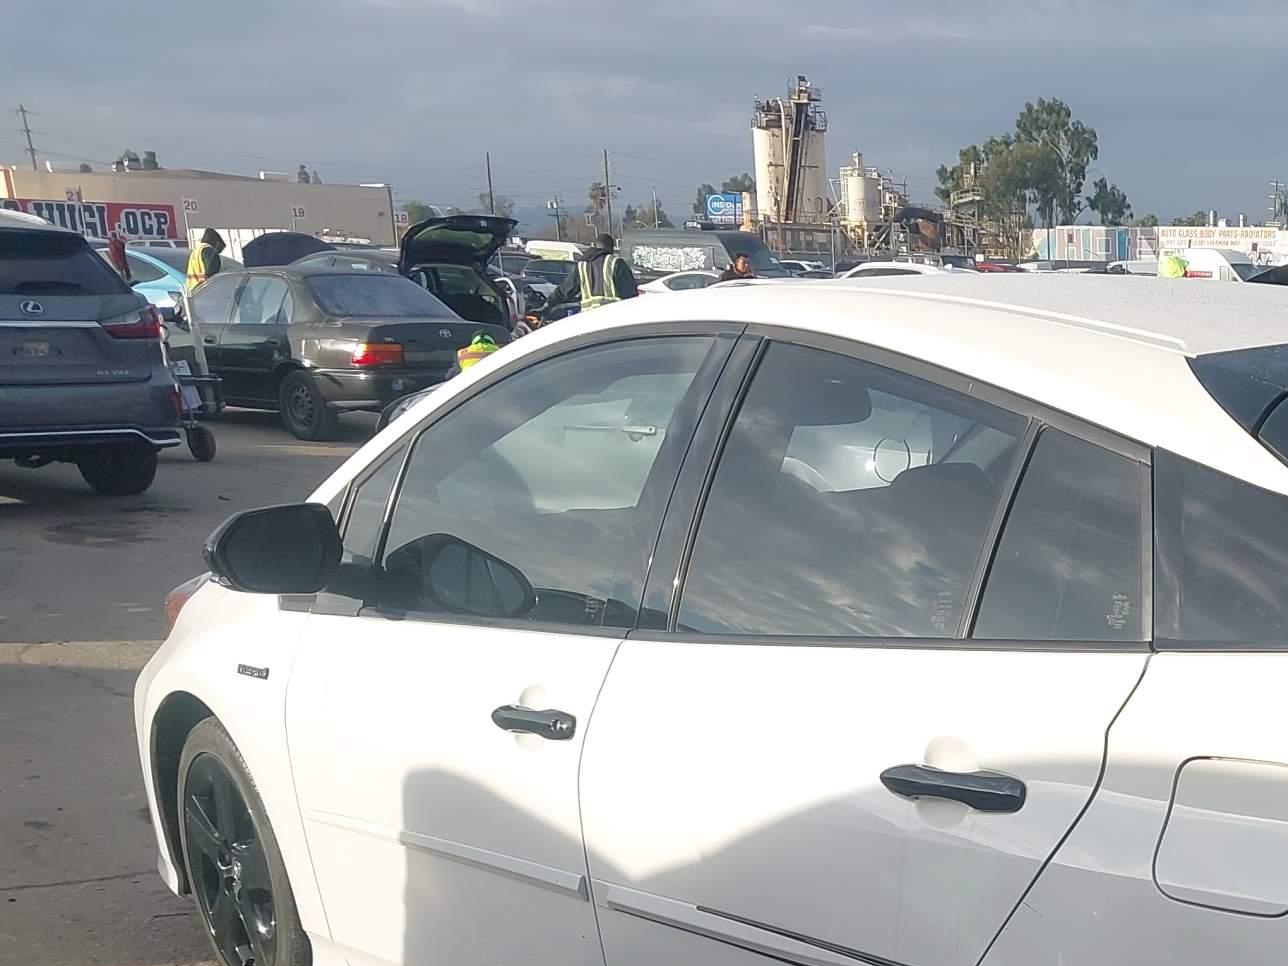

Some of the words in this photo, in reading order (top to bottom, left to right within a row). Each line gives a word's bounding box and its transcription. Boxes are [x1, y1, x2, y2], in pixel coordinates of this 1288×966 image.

[184, 200, 197, 211] 20
[394, 213, 408, 224] 18
[1161, 229, 1176, 238] AUTO
[1178, 229, 1198, 238] GLASS
